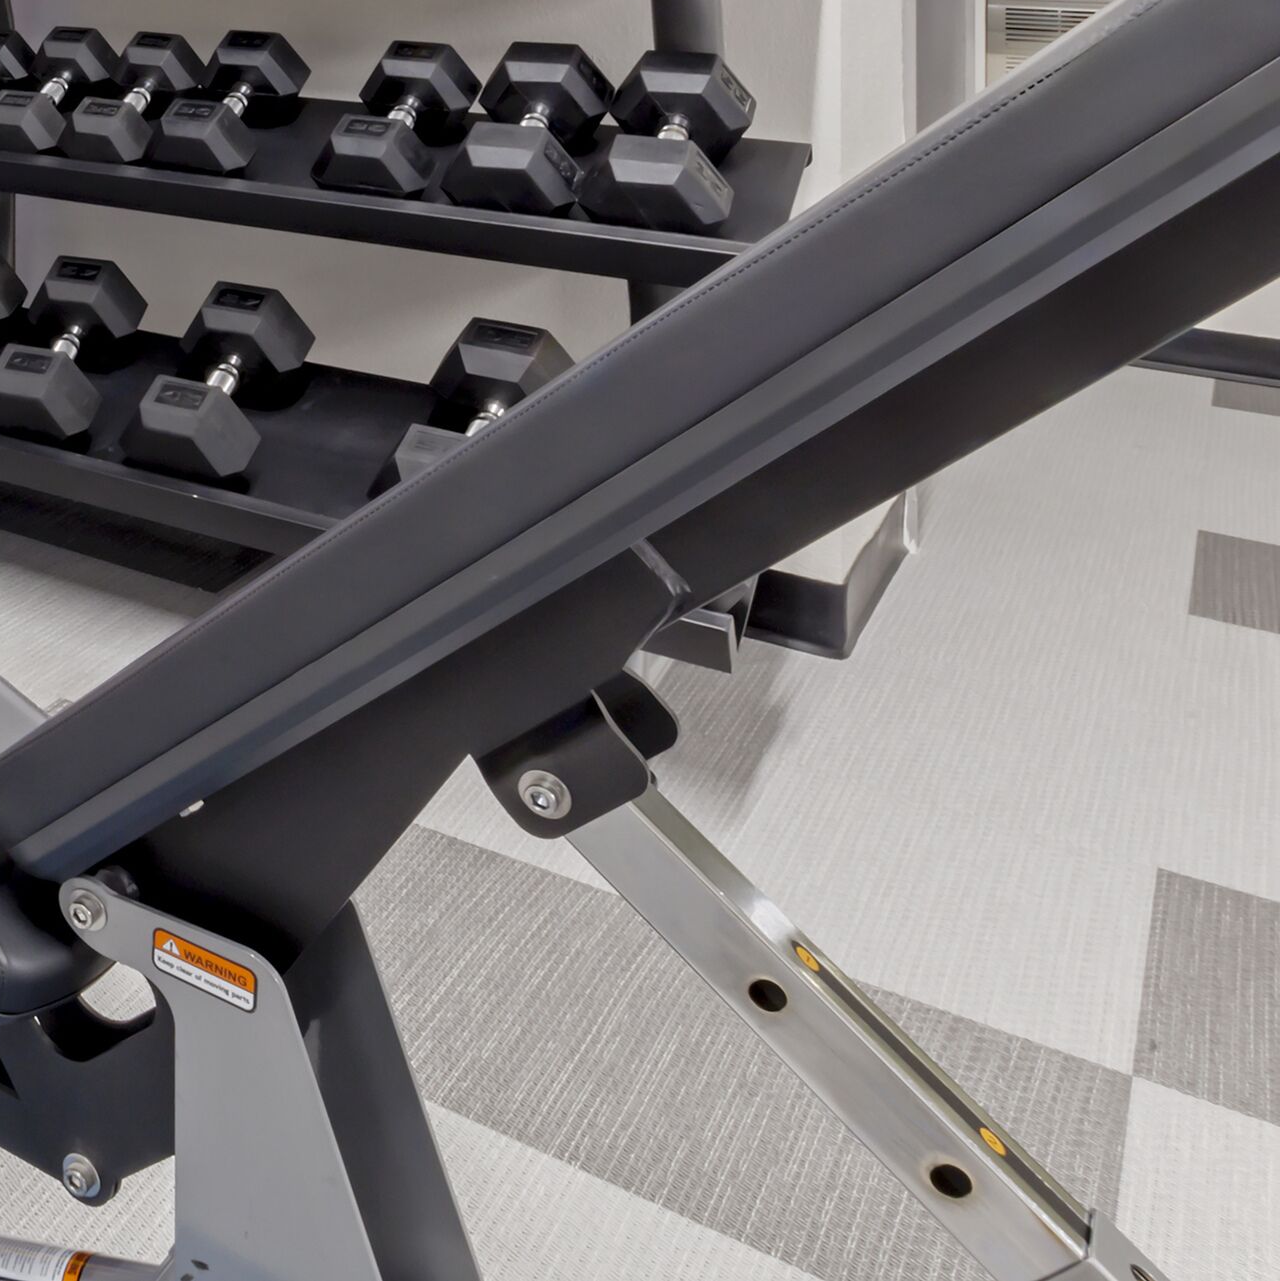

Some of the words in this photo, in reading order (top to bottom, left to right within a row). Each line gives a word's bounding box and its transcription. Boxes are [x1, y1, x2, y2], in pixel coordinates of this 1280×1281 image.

[157, 955, 175, 969] Keep
[175, 965, 193, 977] clear
[203, 978, 230, 997] moving
[231, 991, 250, 1005] parts
[183, 948, 248, 988] WARNING
